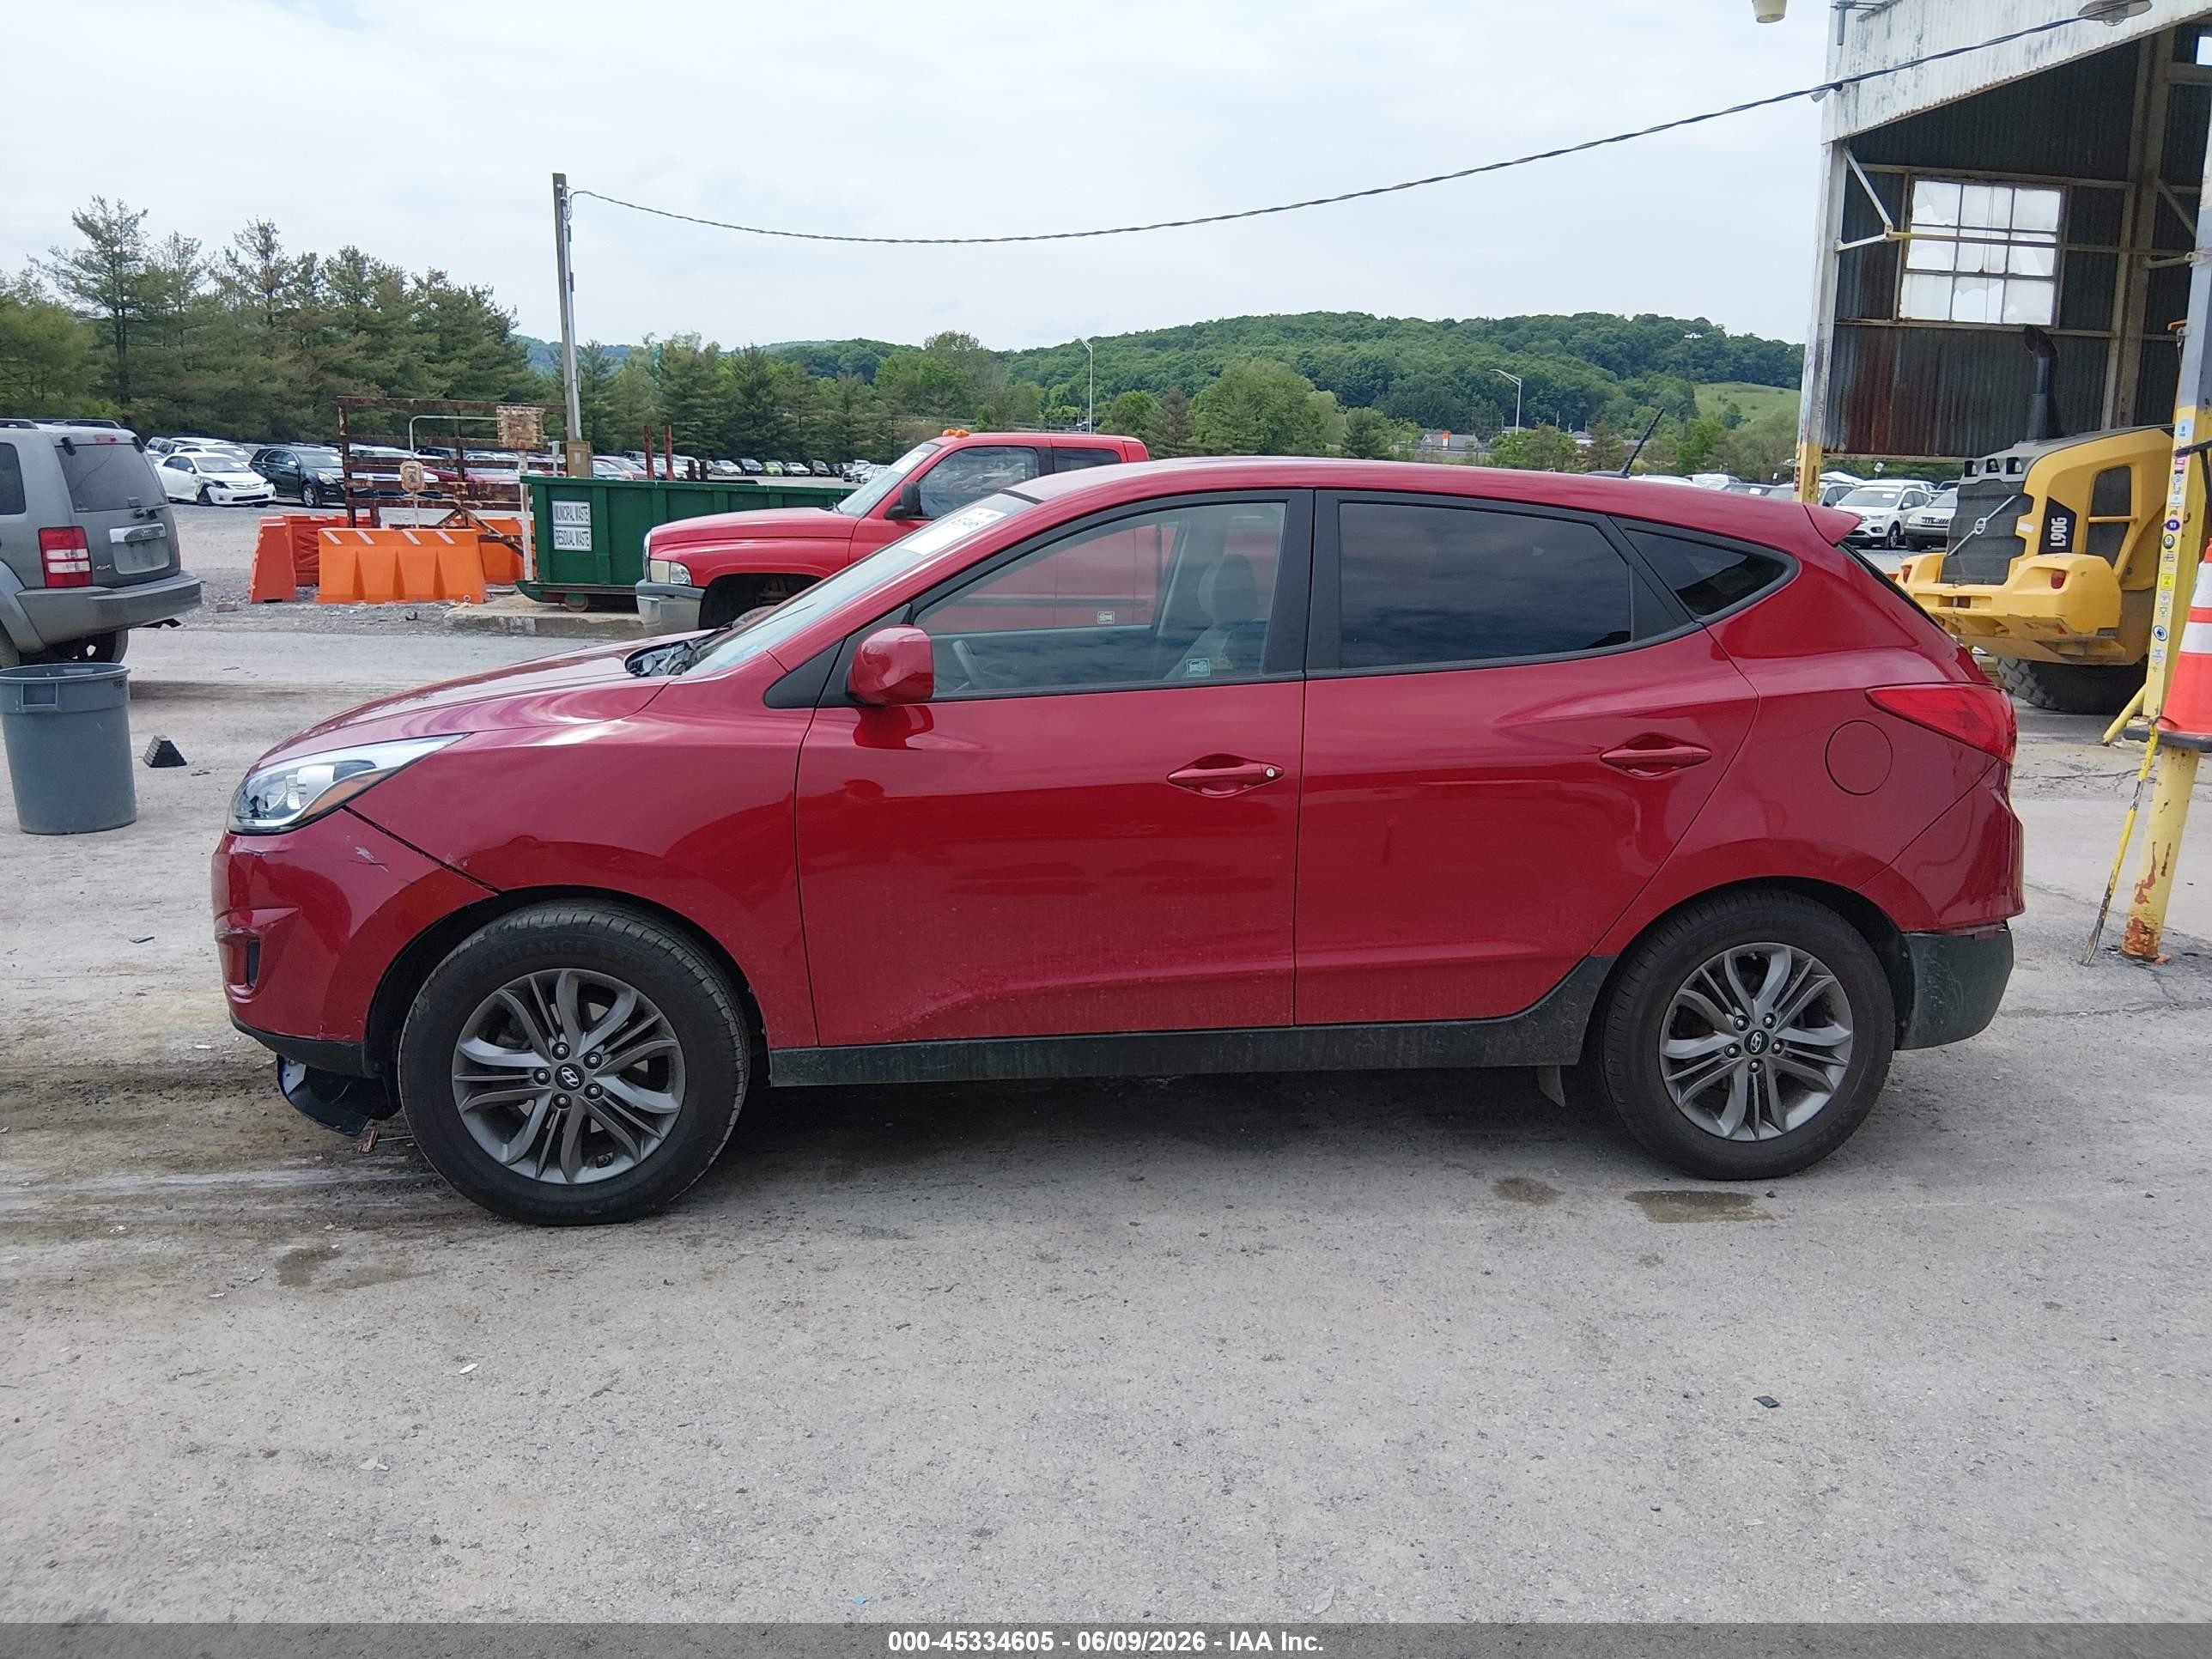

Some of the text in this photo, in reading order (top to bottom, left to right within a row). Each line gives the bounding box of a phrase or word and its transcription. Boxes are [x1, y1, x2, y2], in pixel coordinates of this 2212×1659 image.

[575, 505, 589, 522] WASTE
[556, 529, 590, 547] RESIDUAL WASTE
[2050, 517, 2068, 547] L90G
